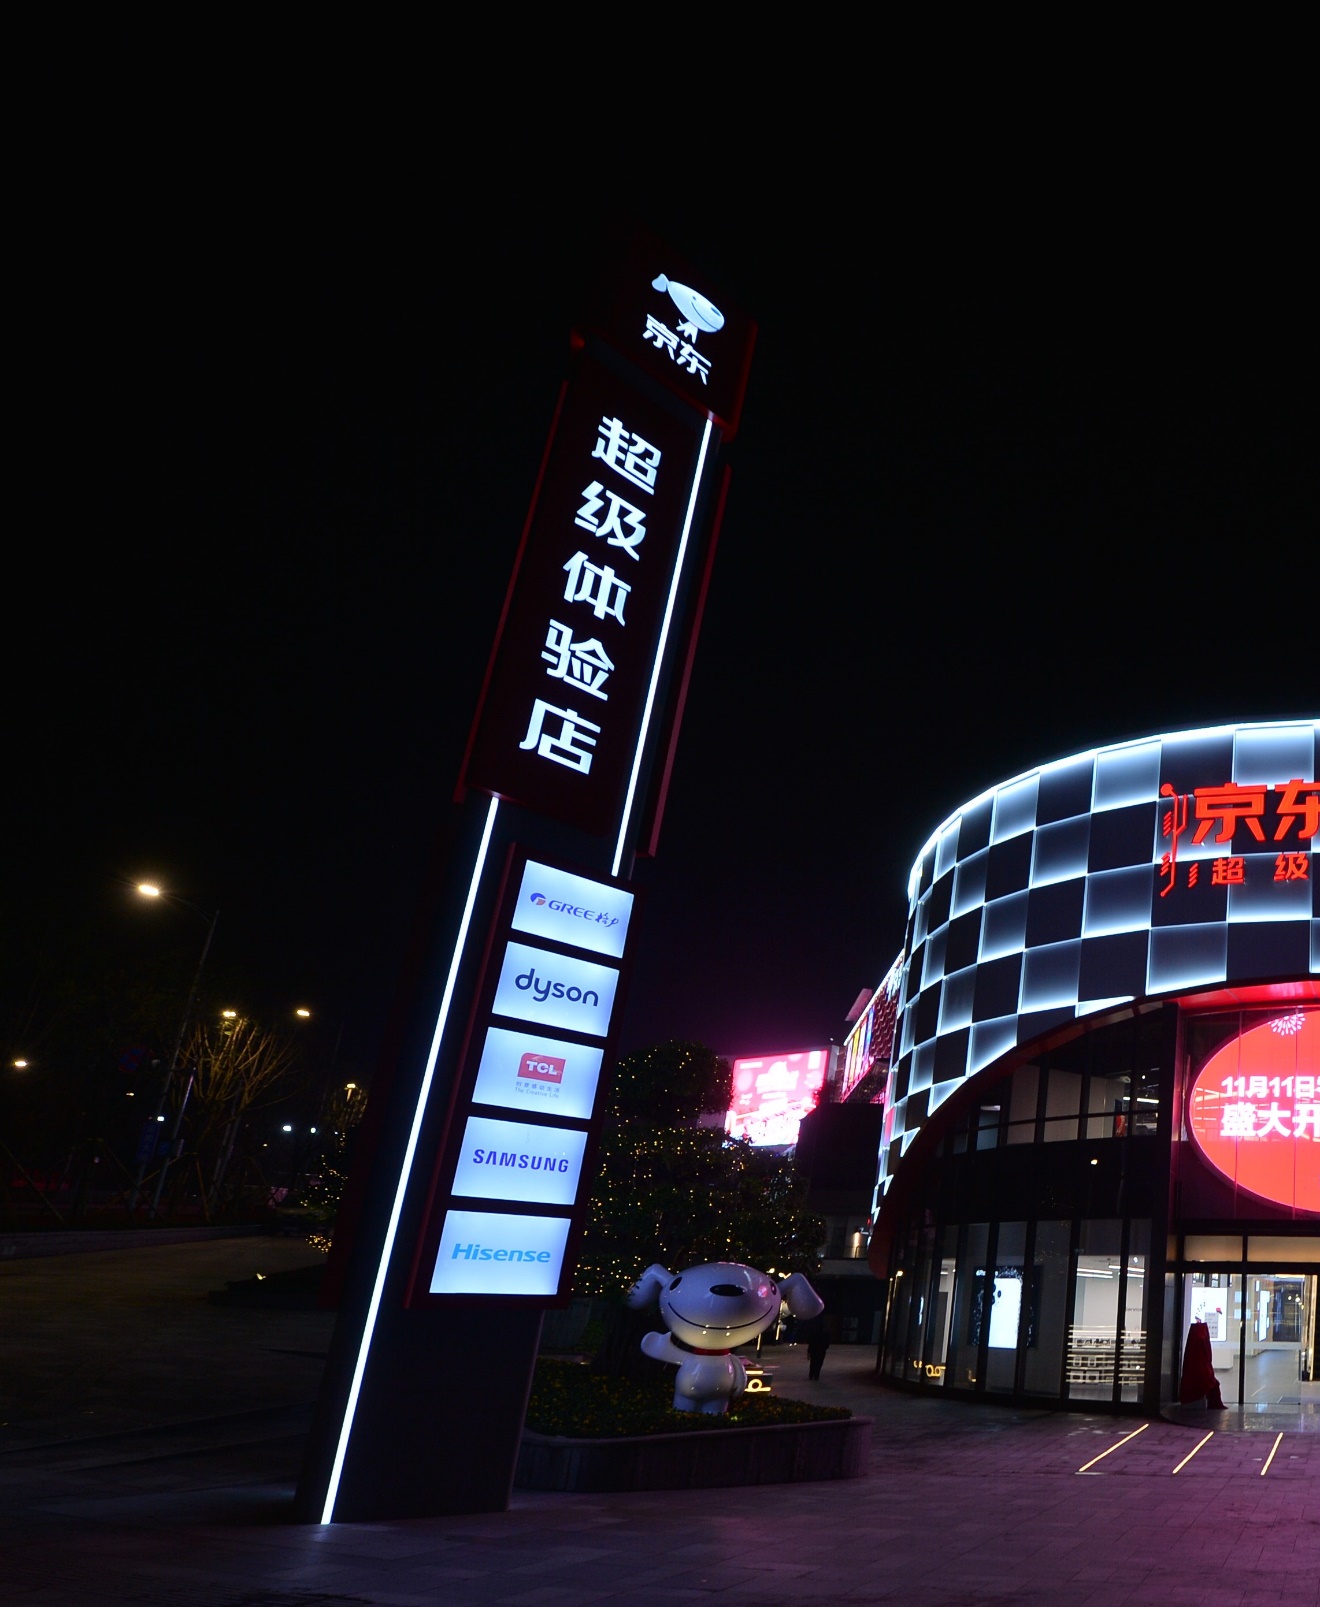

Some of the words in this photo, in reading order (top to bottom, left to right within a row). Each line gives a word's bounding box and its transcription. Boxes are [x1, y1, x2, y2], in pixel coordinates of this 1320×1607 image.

[642, 313, 712, 386] 京东
[519, 415, 662, 776] 超级体验店
[548, 900, 595, 921] GREE
[514, 967, 599, 1007] dyson
[526, 1060, 558, 1076] TCL
[472, 1149, 569, 1173] SAMSUNG
[451, 1243, 551, 1263] Hisense
